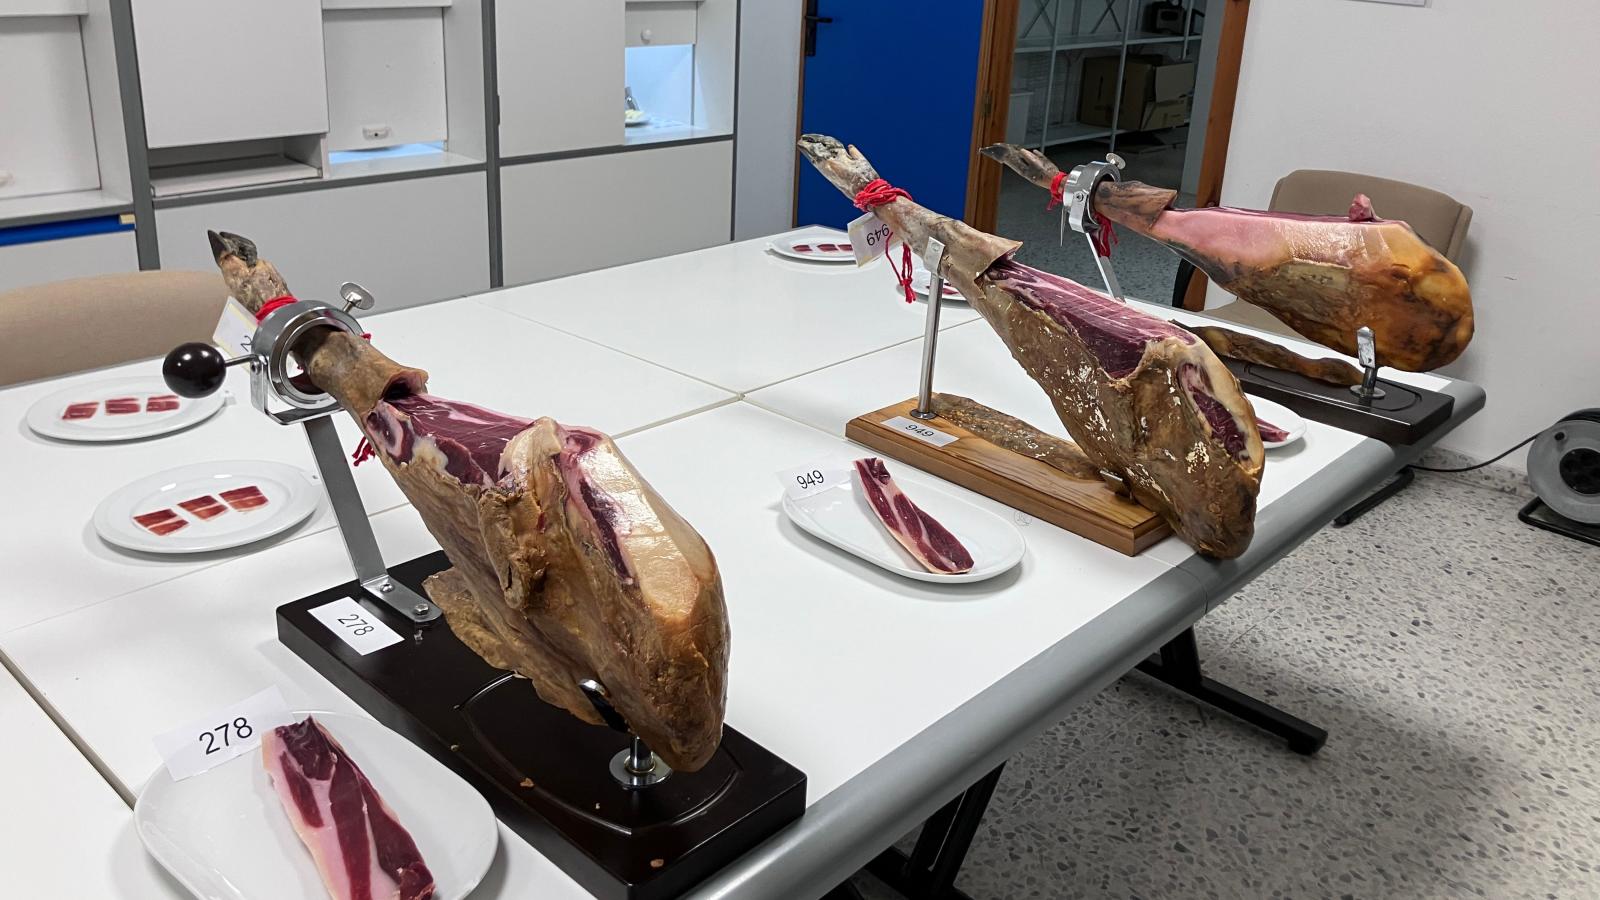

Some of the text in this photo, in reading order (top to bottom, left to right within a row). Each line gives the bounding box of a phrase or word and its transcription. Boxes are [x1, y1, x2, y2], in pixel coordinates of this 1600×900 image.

[866, 223, 890, 246] 949
[905, 424, 935, 437] 949
[796, 469, 825, 489] 949
[337, 613, 375, 636] 278
[198, 717, 253, 755] 278
